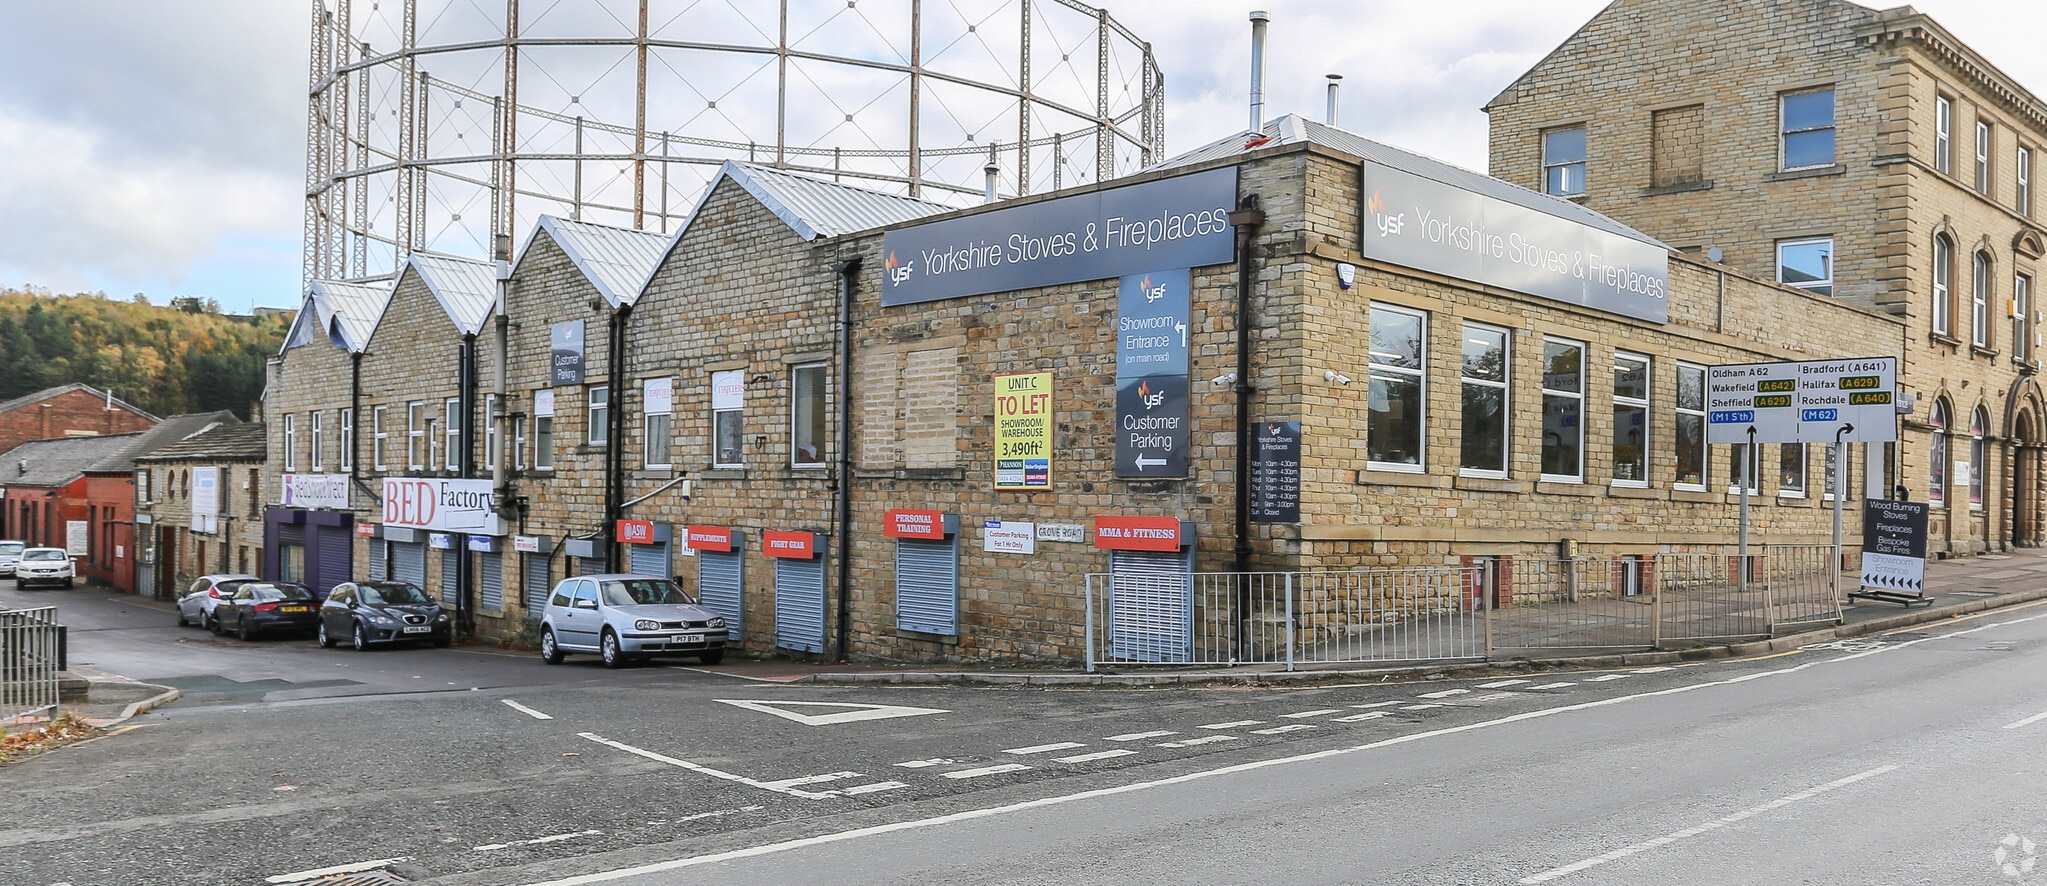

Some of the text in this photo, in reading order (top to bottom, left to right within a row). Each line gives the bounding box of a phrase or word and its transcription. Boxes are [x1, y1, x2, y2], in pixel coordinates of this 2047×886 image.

[1376, 212, 1405, 237] ysf
[921, 207, 1227, 276] Yorkshire Stoves & Fireplaces
[1414, 206, 1665, 300] Yorkshire Stoves & Fireplaces
[890, 260, 914, 287] ysf
[1146, 282, 1166, 304] ysf
[1120, 316, 1173, 331] Showroom
[1126, 335, 1169, 350] Entrance
[554, 355, 579, 366] Customer
[1125, 352, 1170, 365] (on main road)
[1712, 369, 1746, 378] Oldham
[1802, 361, 1887, 374] Bradford (A641)
[557, 368, 576, 381] Parking
[1008, 377, 1037, 389] UNIT C
[1712, 381, 1795, 392] Wakefield (A642)
[1840, 377, 1879, 389] (A629)
[997, 394, 1049, 415] TO LET
[1144, 390, 1165, 410] ysf
[1711, 396, 1791, 407] Sheffield (A629)
[1802, 392, 1891, 405] Rochdale (A640)
[1001, 418, 1044, 428] SHOWROOM/
[1123, 414, 1180, 430] Customer
[1001, 428, 1044, 438] WAREHOUSE
[1130, 433, 1172, 452] Parking
[384, 481, 495, 526] BED Factory
[1870, 501, 1920, 513] Wood Burning
[895, 514, 933, 524] PERSONAL
[1883, 510, 1908, 520] Stoves
[632, 524, 647, 537] ASW
[896, 524, 931, 533] TRAINING
[1038, 527, 1082, 537] GROVE ROAD
[1099, 527, 1175, 539] MMA & FITNESS
[1876, 523, 1913, 533] Fireplaces
[690, 533, 727, 543] SUPPLEMENTS
[989, 531, 1029, 540] Customer Parking
[1878, 536, 1910, 546] Bespoke
[770, 540, 805, 549] FIGHT GEAR
[1011, 541, 1023, 549] Only
[1876, 544, 1911, 554] Gas Fires
[1872, 554, 1913, 566] Showroom
[1875, 564, 1908, 575] Entrance
